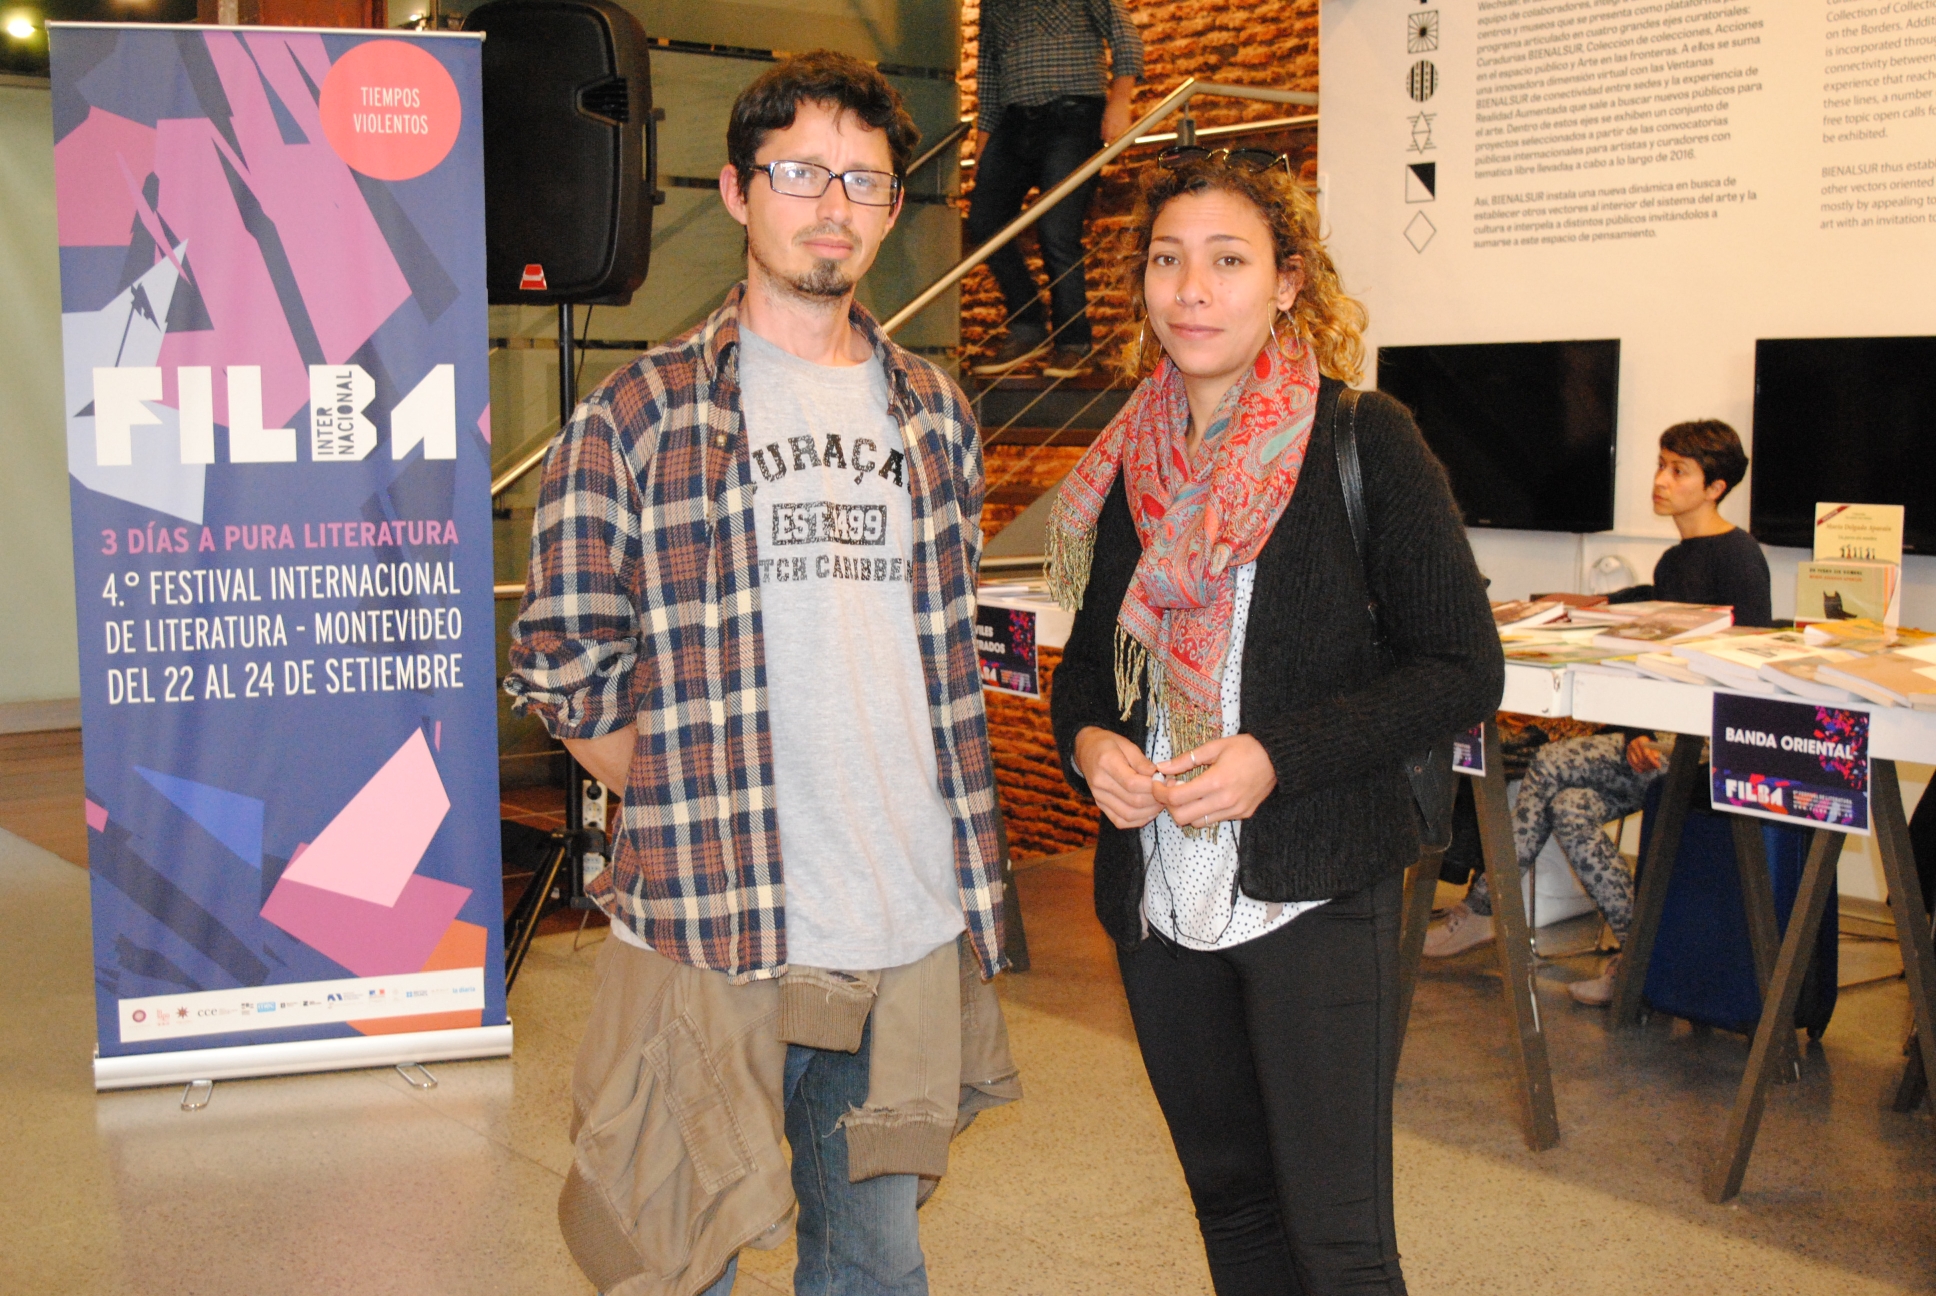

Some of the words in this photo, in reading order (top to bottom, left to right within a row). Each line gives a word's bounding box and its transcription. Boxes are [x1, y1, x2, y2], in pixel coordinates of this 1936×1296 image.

[1827, 8, 1877, 23] Collection
[1879, 3, 1890, 15] of
[1523, 30, 1570, 47] articulado
[1572, 31, 1583, 40] en
[1585, 25, 1617, 38] cuatro
[1619, 18, 1660, 35] grandes
[1662, 16, 1682, 28] ejes
[1684, 6, 1750, 23] curatoriales:
[1826, 30, 1839, 39] on
[1841, 25, 1858, 38] the
[1860, 21, 1902, 35] Borders.
[1826, 46, 1832, 57] is
[1835, 36, 1901, 56] incorporated
[1476, 86, 1492, 95] una
[1494, 78, 1544, 93] innovadora
[1546, 70, 1594, 86] dimensión
[1596, 65, 1628, 80] virtual
[1629, 66, 1648, 76] con
[1650, 62, 1664, 73] las
[1666, 58, 1714, 71] Ventanas
[1826, 58, 1887, 74] connectivity
[1889, 54, 1936, 67] between
[1824, 77, 1879, 92] experience
[1882, 72, 1903, 84] that
[360, 86, 421, 108] TIEMPOS
[1824, 96, 1850, 109] these
[1853, 93, 1878, 105] lines,
[1890, 86, 1932, 101] number
[353, 113, 429, 136] VIOLENTOS
[1824, 114, 1842, 126] free
[1844, 112, 1870, 125] topic
[1872, 111, 1900, 122] open
[1902, 105, 1925, 118] calls
[1476, 137, 1518, 152] proyectos
[1520, 130, 1586, 146] seleccionados
[1595, 126, 1623, 140] partir
[1626, 124, 1638, 135] de
[1640, 123, 1654, 134] las
[1656, 116, 1728, 132] convocatorias
[1512, 144, 1583, 161] internacionales
[1585, 144, 1608, 156] para
[1610, 139, 1646, 151] artistas
[1656, 134, 1709, 147] curadores
[1711, 133, 1731, 142] con
[1823, 131, 1835, 143] be
[1837, 126, 1888, 142] exhibited.
[1514, 163, 1535, 175] libre
[1582, 157, 1606, 169] cabo
[1616, 155, 1625, 166] lo
[1626, 154, 1653, 166] largo
[1654, 152, 1667, 163] de
[1670, 149, 1696, 162] 2016.
[1822, 161, 1878, 177] BIENALSUR
[1880, 160, 1903, 172] thus
[1491, 190, 1544, 205] BIENALSUR
[1545, 188, 1576, 201] instala
[1578, 189, 1596, 198] una
[1597, 187, 1626, 197] nueva
[1628, 182, 1673, 194] dinámica
[1675, 182, 1688, 191] en
[1690, 178, 1721, 190] busca
[1722, 176, 1736, 187] de
[1822, 182, 1847, 195] other
[1850, 181, 1886, 193] vectors
[1889, 175, 1934, 190] oriented
[1474, 208, 1520, 220] establecer
[1522, 206, 1546, 217] otros
[1548, 204, 1588, 215] vectores
[1590, 201, 1598, 212] al
[1600, 199, 1636, 211] interior
[1639, 196, 1654, 208] del
[1656, 196, 1695, 207] sistema
[1697, 192, 1713, 204] del
[1715, 192, 1737, 203] arte
[1747, 190, 1757, 201] la
[1822, 198, 1854, 212] mostly
[1856, 197, 1868, 211] by
[1871, 194, 1924, 210] appealing
[1474, 222, 1504, 234] cultura
[1513, 218, 1554, 232] interpela
[1562, 216, 1603, 228] distintos
[1605, 213, 1646, 228] públicos
[1648, 208, 1709, 222] invitándolos
[1821, 218, 1833, 229] art
[1836, 215, 1858, 228] with
[1860, 218, 1873, 227] an
[1875, 214, 1925, 226] invitation
[1474, 238, 1511, 248] sumarse
[1520, 235, 1539, 245] este
[1540, 232, 1576, 246] espacio
[1578, 231, 1590, 242] de
[93, 364, 456, 466] FILBA
[336, 370, 355, 456] NACIONAL
[317, 406, 334, 456] INTER
[751, 433, 911, 495] URAÇA
[101, 530, 117, 556] 3
[128, 521, 189, 554] DÍAS
[198, 526, 216, 552] A
[224, 524, 295, 550] PURA
[304, 519, 459, 548] LITERATURA
[150, 568, 261, 606] FESTIVAL
[270, 562, 460, 600] INTERNACIONAL
[105, 620, 135, 654] DE
[145, 614, 288, 653] LITERATURA
[315, 607, 462, 645] MONTEVIDEO
[107, 667, 155, 704] DEL
[164, 665, 194, 702] 22
[204, 663, 236, 699] AL
[244, 661, 274, 698] 24
[284, 659, 316, 695] DE
[325, 653, 464, 694] SETIEMBRE
[1725, 726, 1777, 750] BANDA
[1780, 735, 1854, 761] ORIENTAL
[1725, 778, 1783, 808] FILBA
